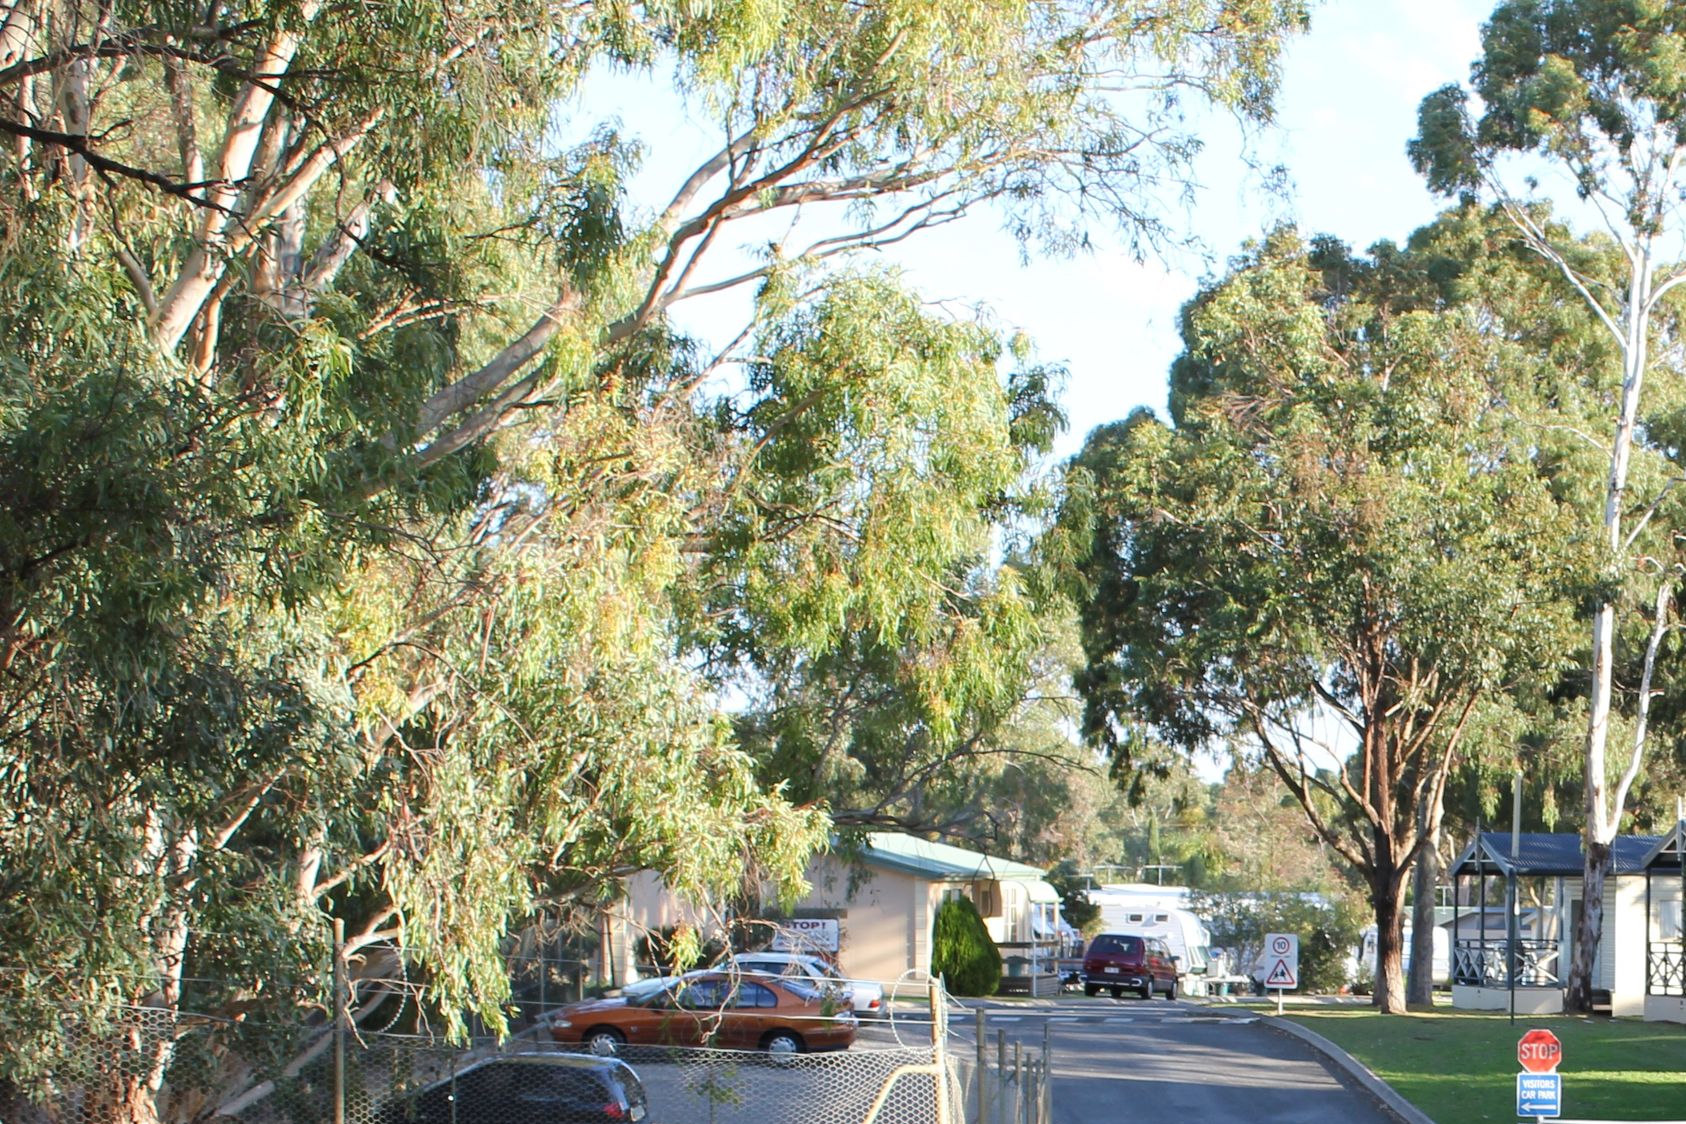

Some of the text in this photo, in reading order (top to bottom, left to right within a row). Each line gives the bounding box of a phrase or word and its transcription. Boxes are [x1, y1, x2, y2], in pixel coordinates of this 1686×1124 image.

[1276, 941, 1286, 950] 10
[1521, 1043, 1558, 1059] STOP
[1522, 1079, 1556, 1089] VISITORS
[1521, 1090, 1557, 1100] CAR PARK
